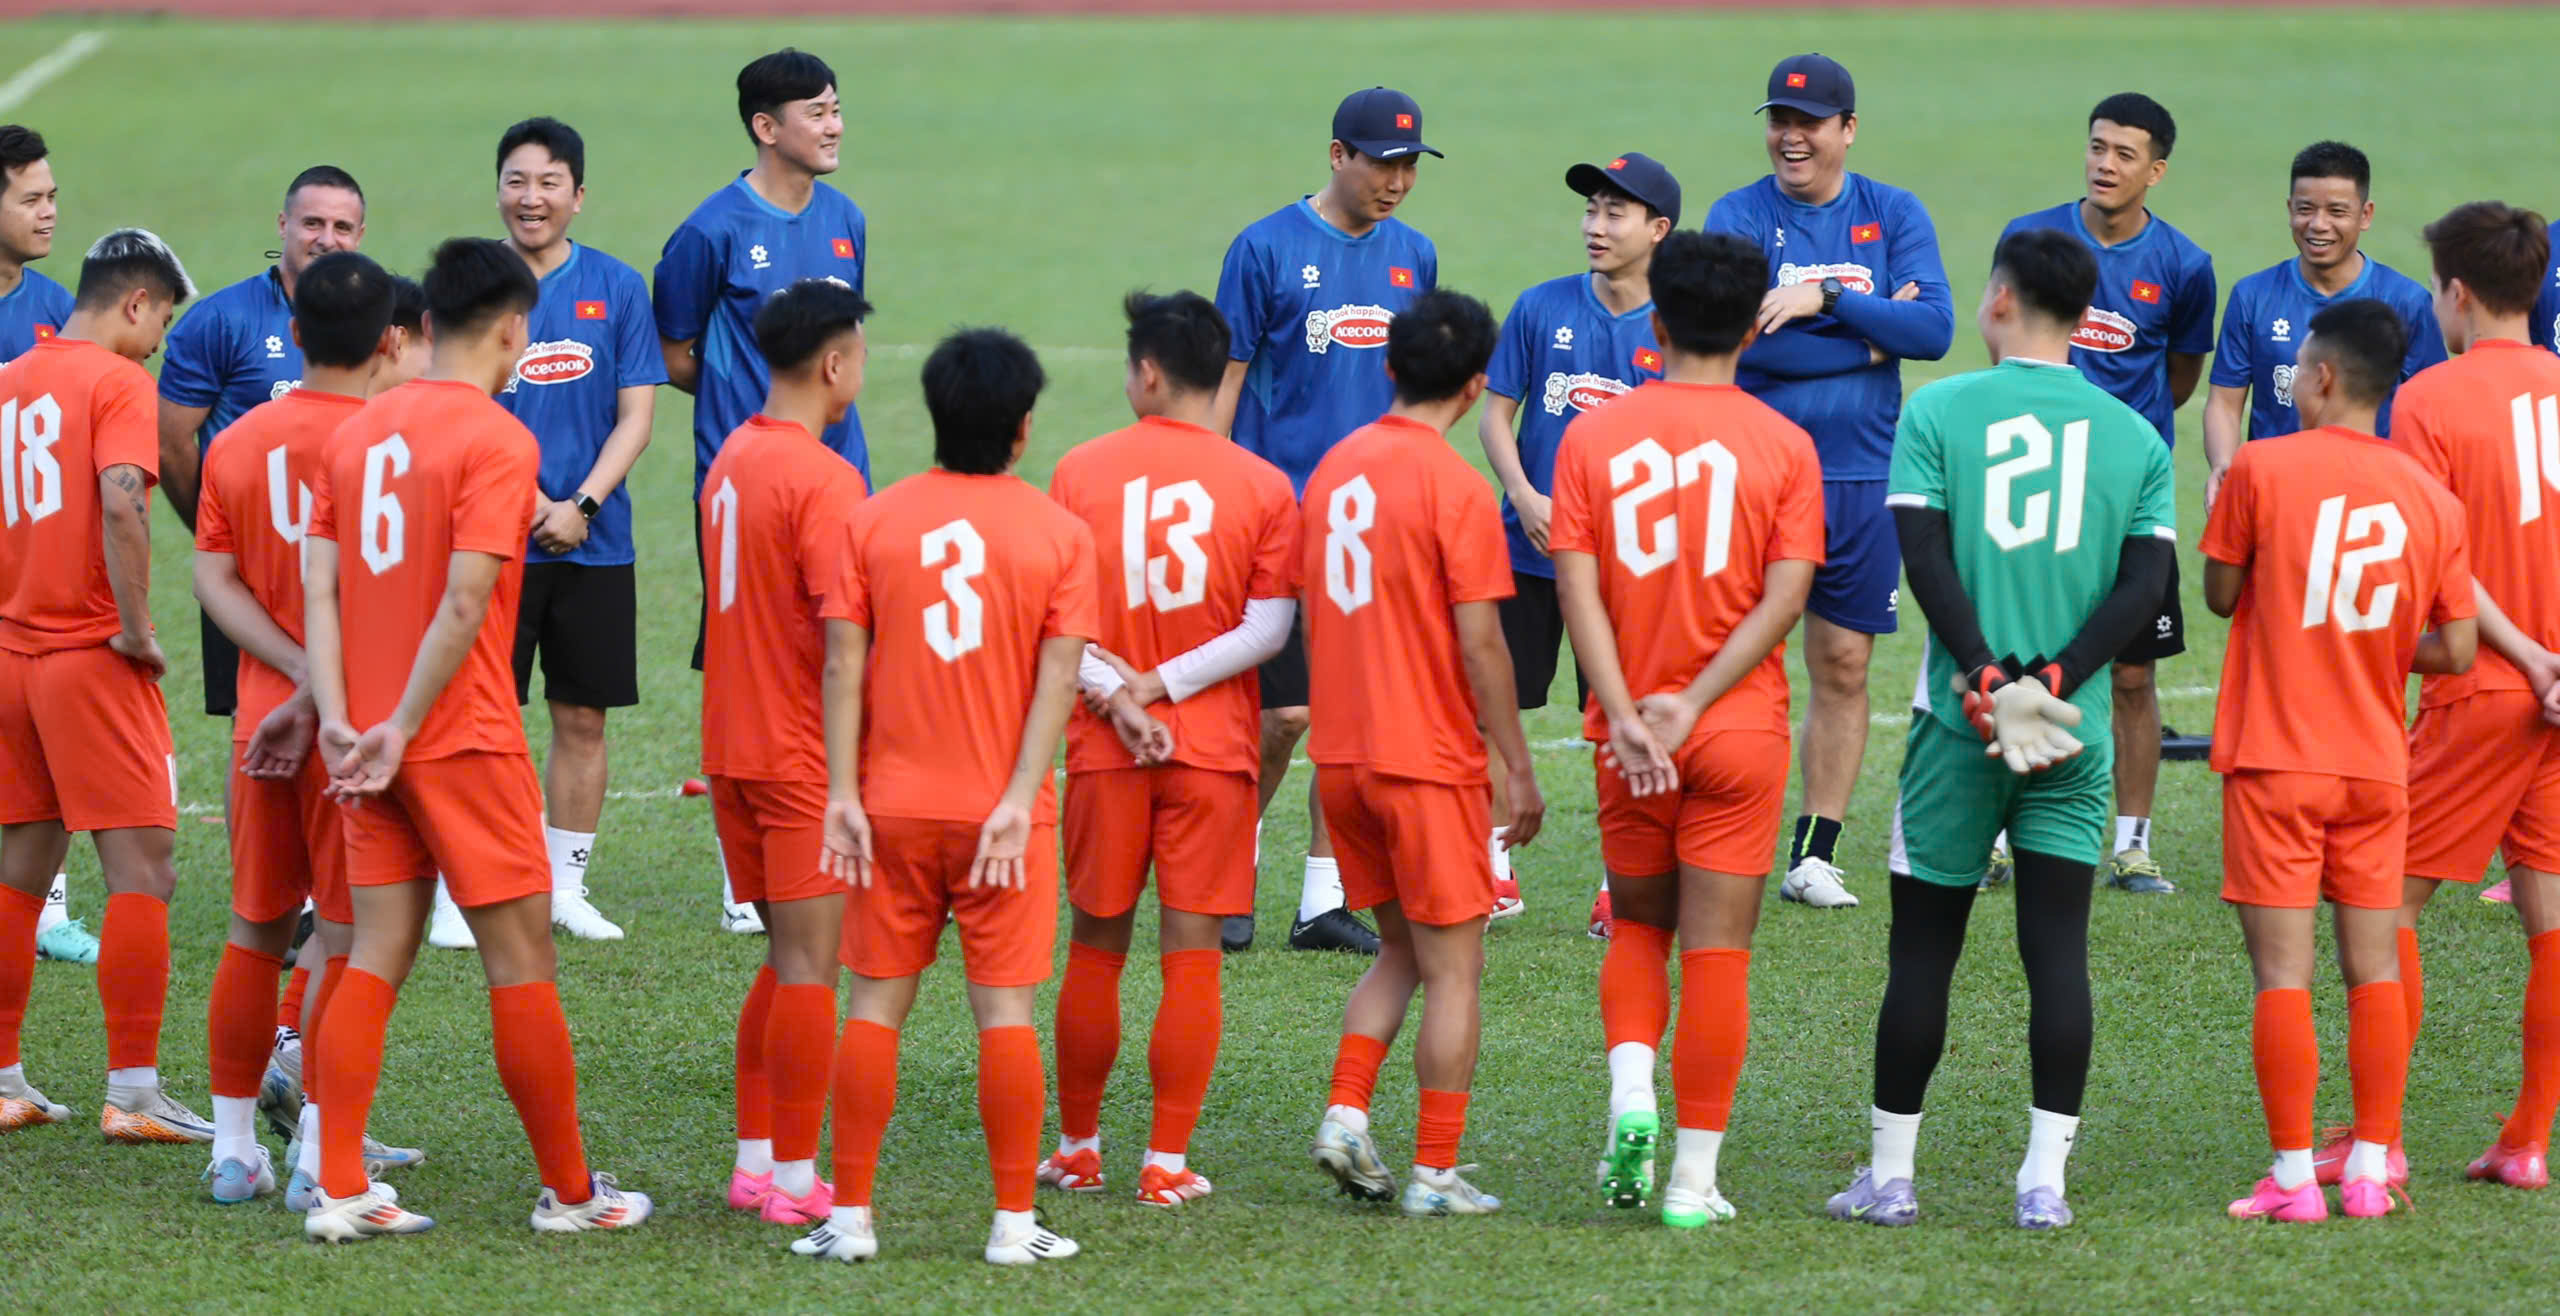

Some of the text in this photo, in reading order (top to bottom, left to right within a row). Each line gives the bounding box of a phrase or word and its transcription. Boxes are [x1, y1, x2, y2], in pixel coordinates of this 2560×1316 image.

[1328, 309, 1349, 321] Cook
[0, 392, 62, 529] 18
[267, 444, 312, 584] 4
[361, 432, 411, 575] 6
[1609, 437, 1737, 578] 27
[1985, 413, 2090, 553] 21
[921, 518, 985, 662] 3
[1123, 475, 1214, 613] 13
[1326, 473, 1377, 616] 8
[2303, 494, 2408, 632] 12
